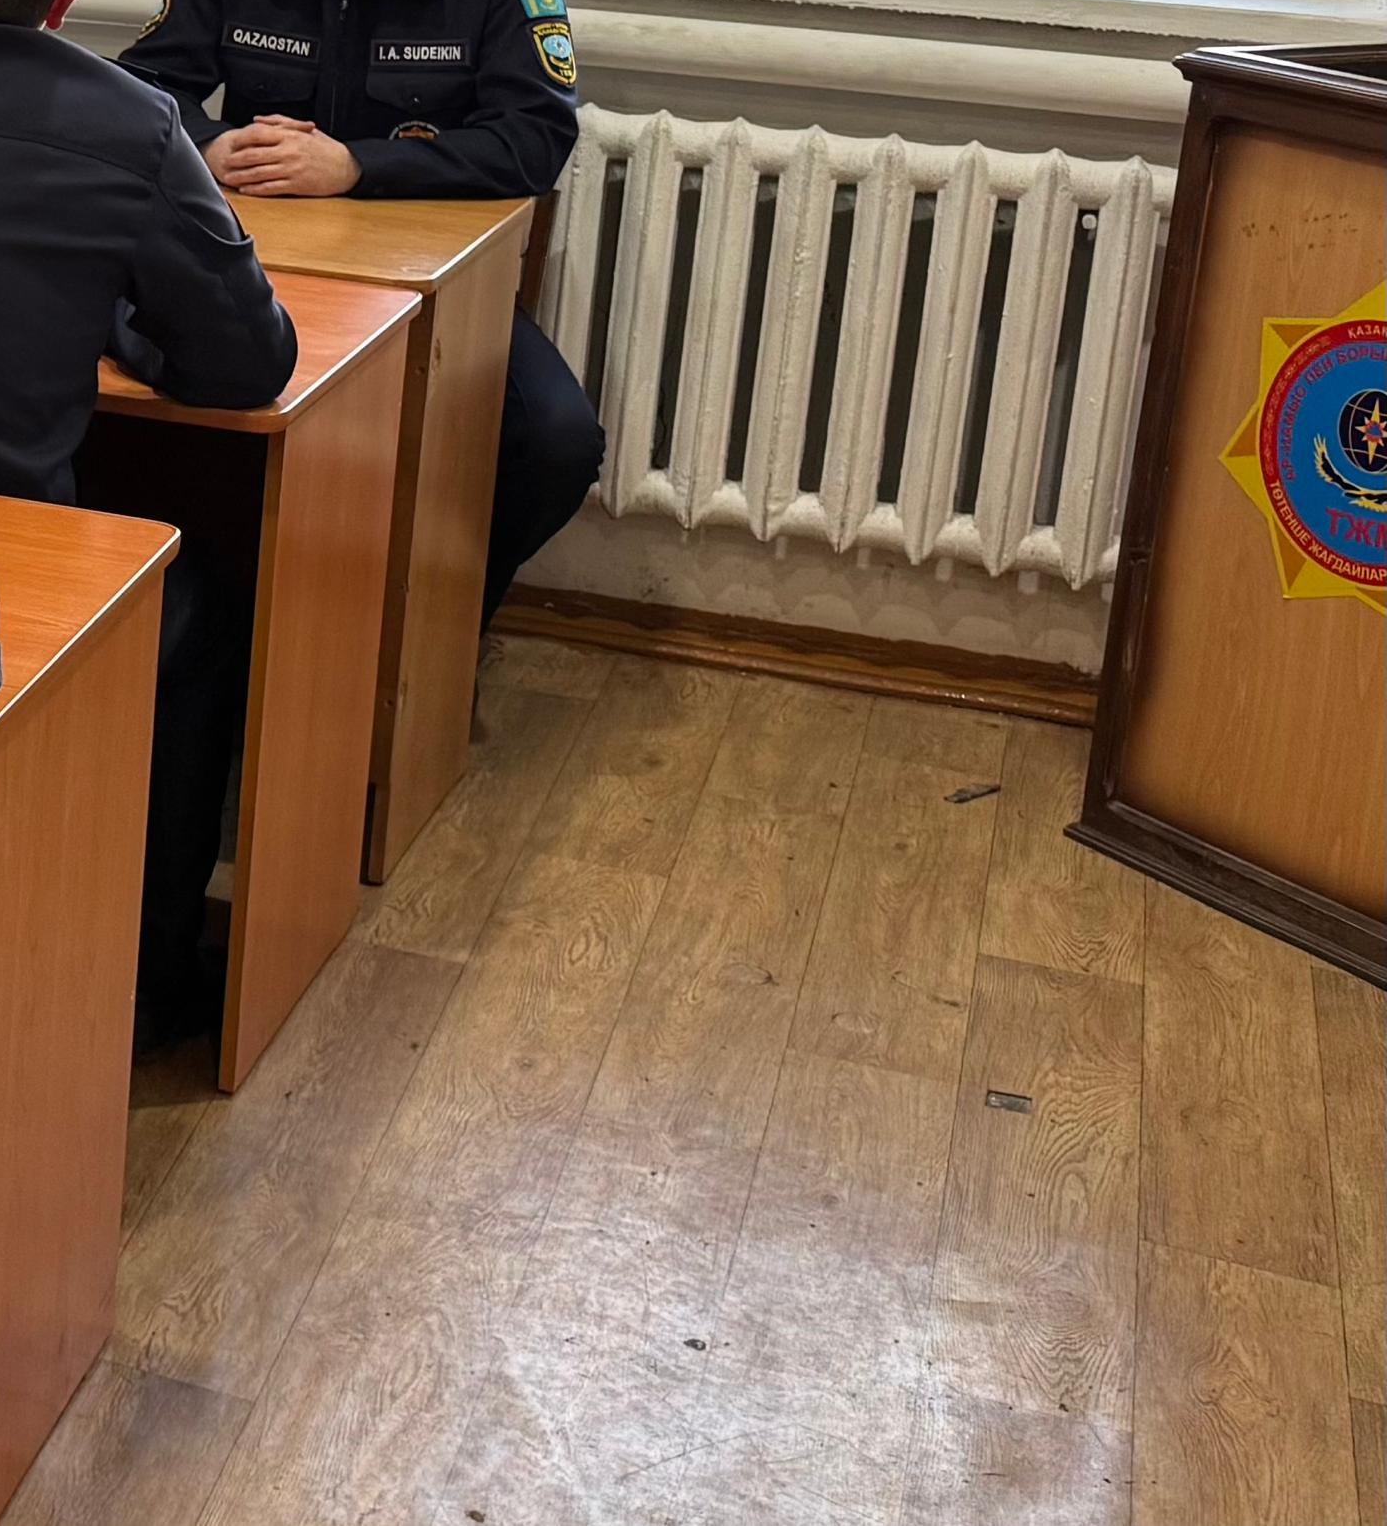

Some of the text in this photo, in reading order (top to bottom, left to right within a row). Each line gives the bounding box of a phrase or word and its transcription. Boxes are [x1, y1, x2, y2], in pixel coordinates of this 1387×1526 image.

[232, 28, 311, 57] QAZAQSTAN
[403, 45, 462, 61] SUDEIKIN
[1269, 478, 1312, 547] ТӨТЕНШЕ
